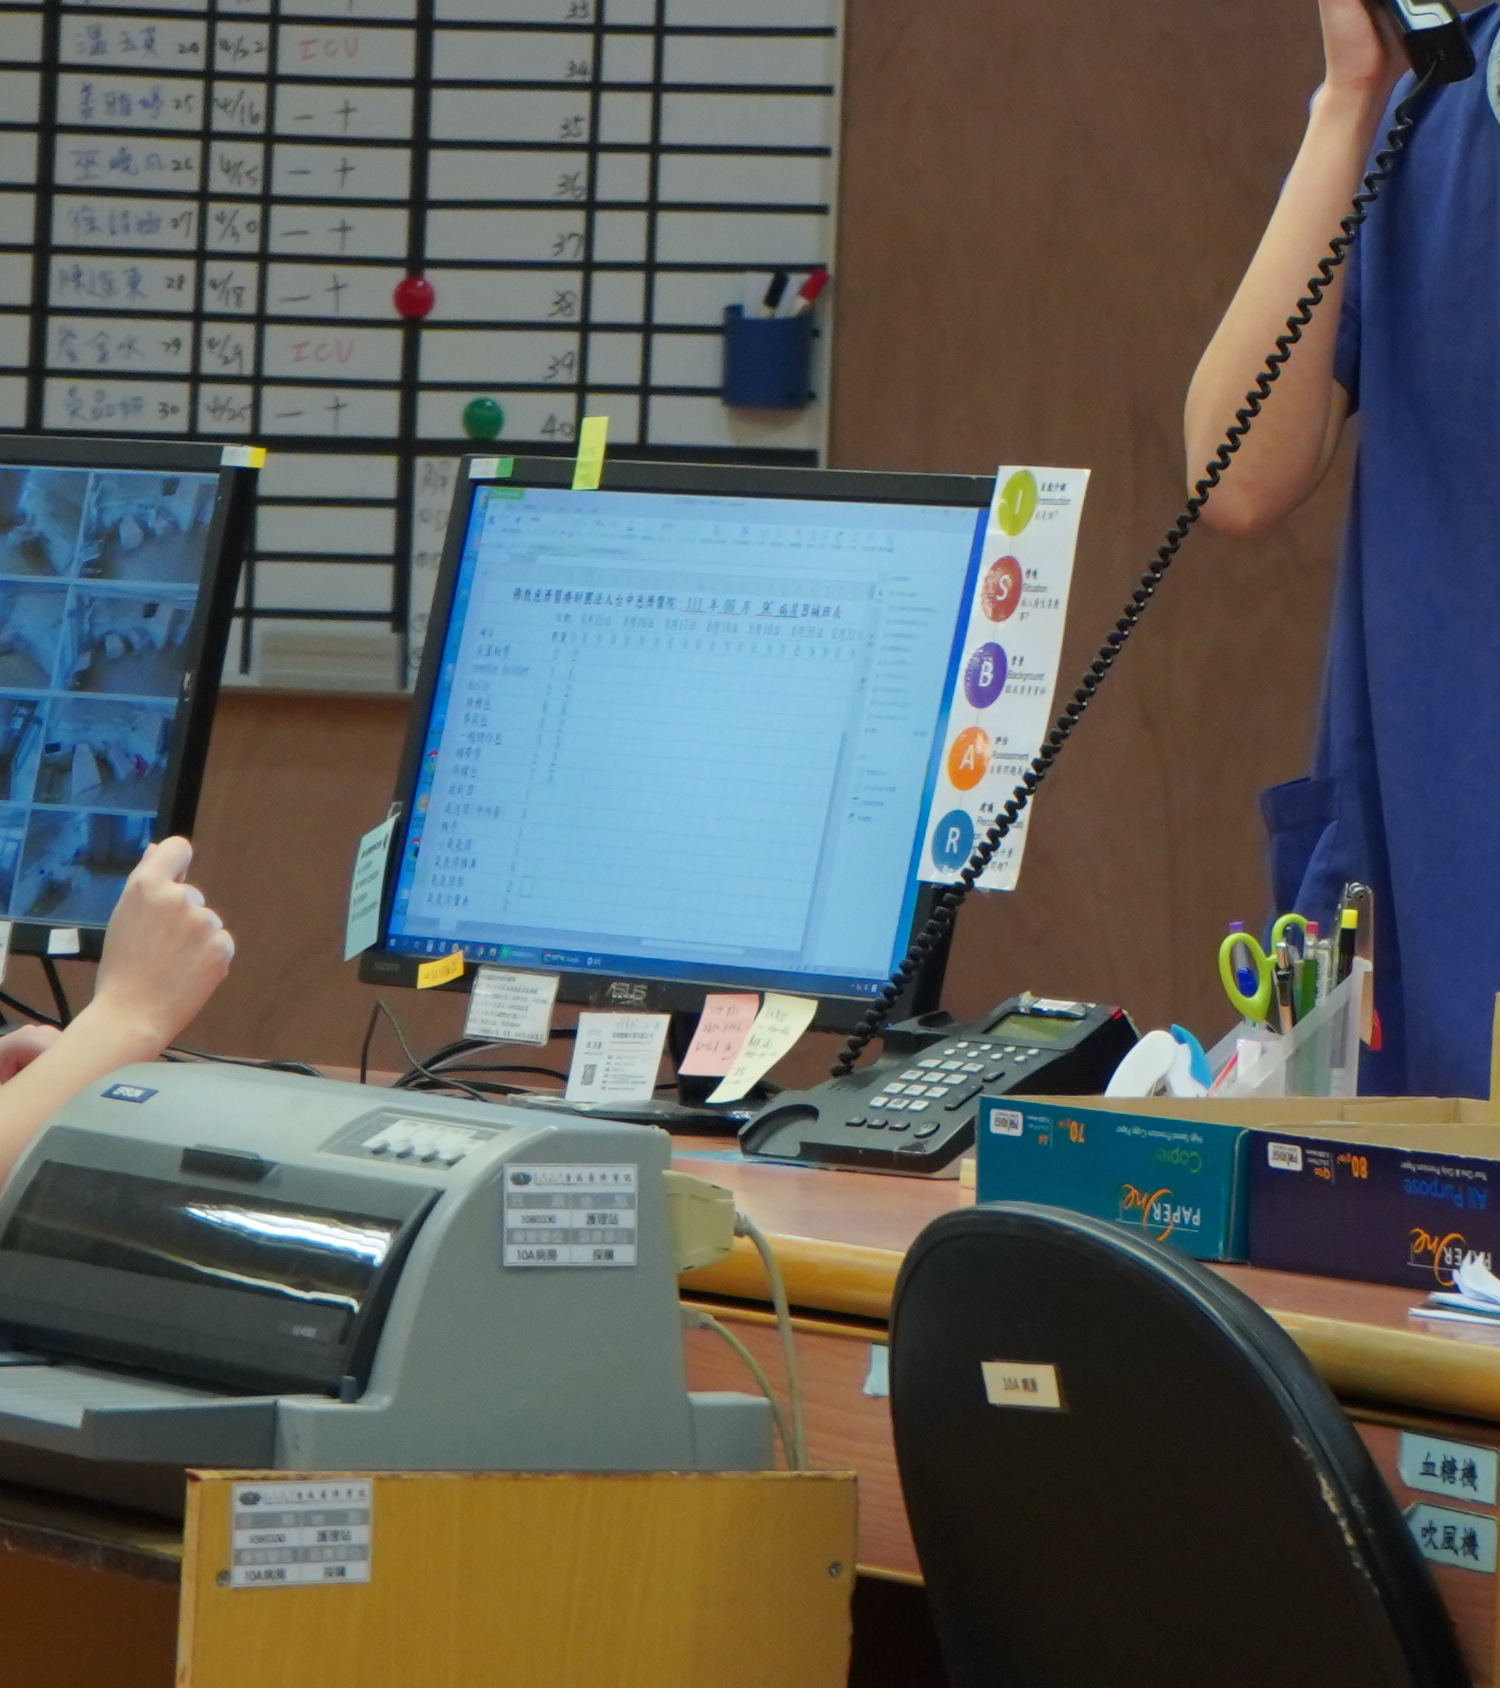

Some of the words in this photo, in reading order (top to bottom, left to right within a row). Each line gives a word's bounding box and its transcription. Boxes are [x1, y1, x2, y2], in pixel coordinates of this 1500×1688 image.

[298, 36, 359, 63] ICU
[565, 60, 589, 79] 34
[561, 116, 584, 139] 35
[552, 233, 584, 257] 37
[548, 290, 577, 318] 38
[292, 339, 357, 365] ICU
[544, 352, 575, 381] 39
[996, 575, 1011, 601] S
[978, 660, 994, 689] B
[1008, 670, 1045, 681] Background
[960, 744, 974, 771] A
[945, 824, 960, 853] R
[1155, 1147, 1202, 1173] Copier
[1352, 1156, 1368, 1179] 80
[1402, 1178, 1465, 1208] Purpose
[1467, 1186, 1489, 1210] All
[1153, 1201, 1201, 1226] PAPER
[1408, 1227, 1466, 1286] One
[1419, 1451, 1478, 1492] 血糖機
[1419, 1520, 1480, 1562] 吹風機
